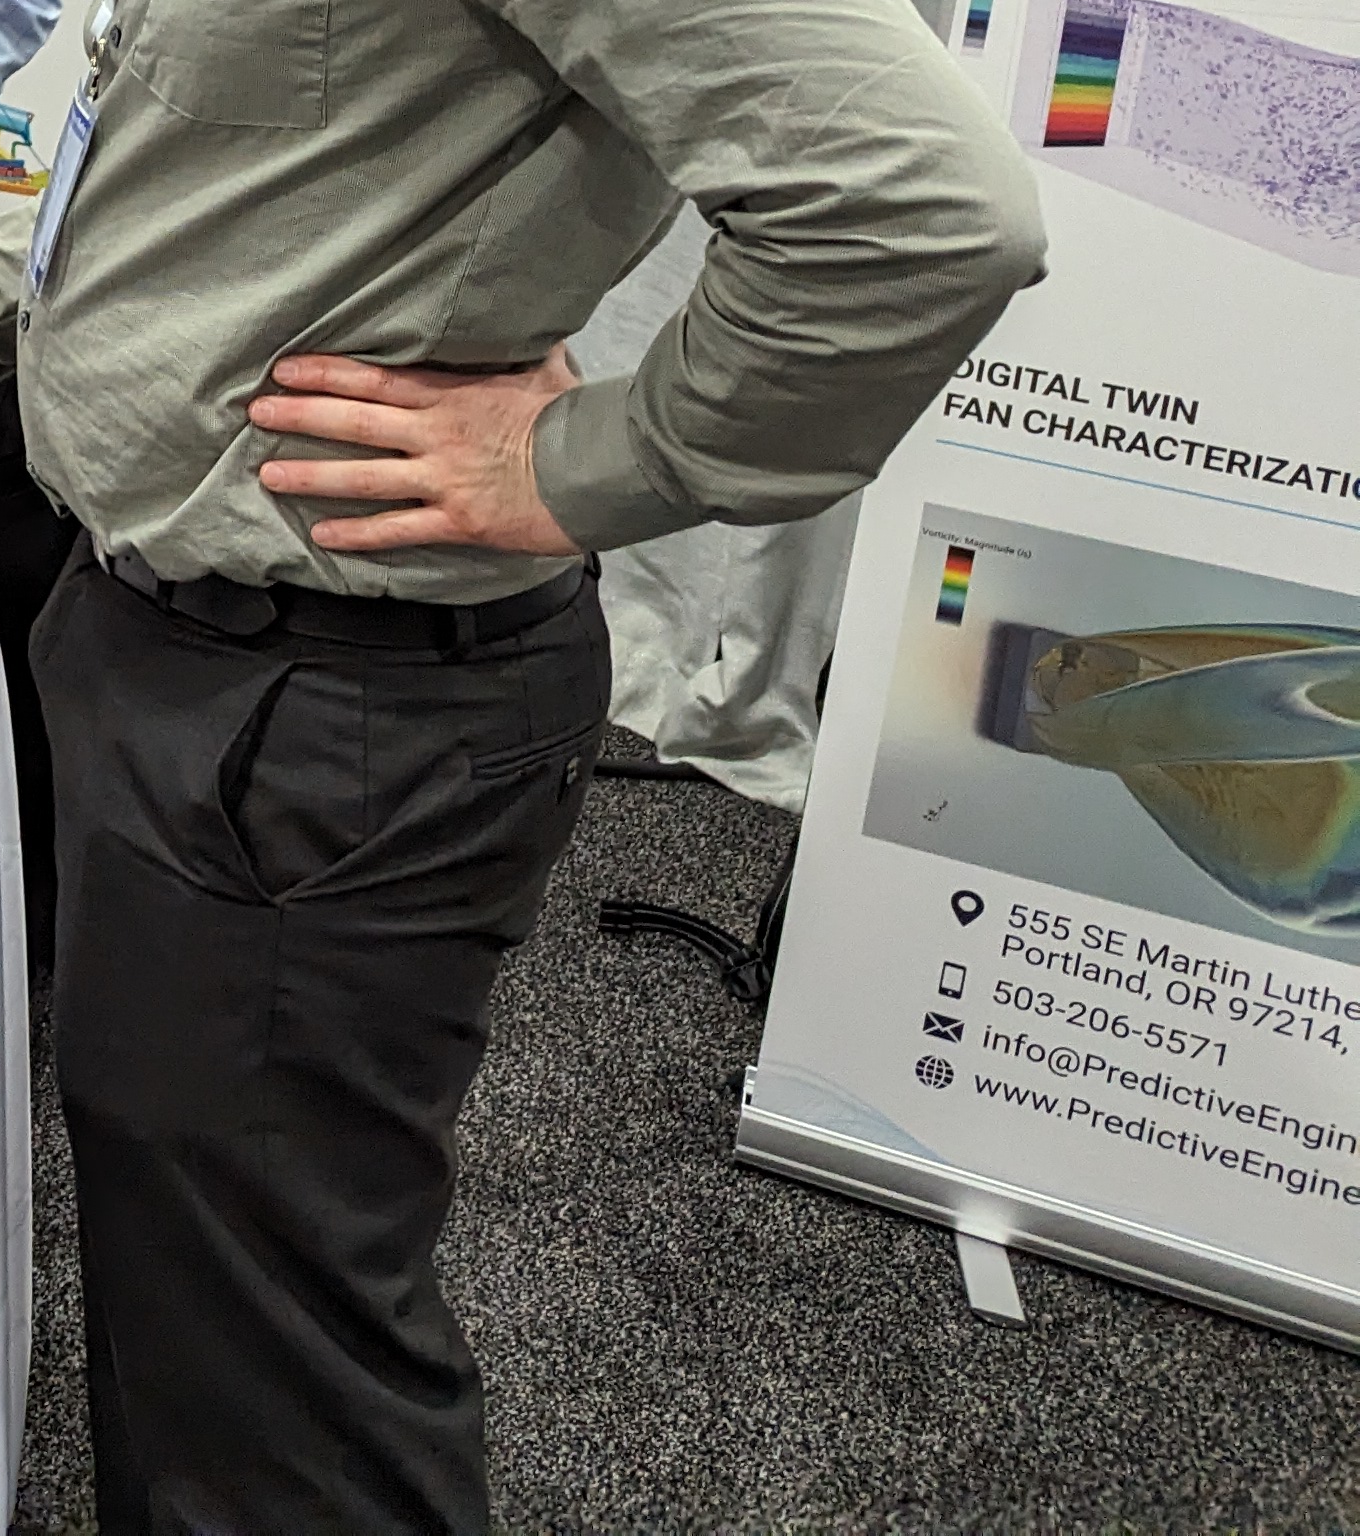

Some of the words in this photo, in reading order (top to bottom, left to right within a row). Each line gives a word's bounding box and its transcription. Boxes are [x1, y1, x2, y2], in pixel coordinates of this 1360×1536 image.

[942, 392, 1013, 429] FAN
[952, 357, 1091, 404] DIGITAL
[1102, 382, 1200, 425] TWIN
[1001, 933, 1152, 1002] Portland,
[1166, 980, 1218, 1015] OR
[1228, 996, 1349, 1056] 97214,
[1008, 903, 1072, 941] 555
[1081, 924, 1128, 957] SE
[1137, 937, 1251, 991] Martin
[1262, 971, 1360, 1021] Luthe
[992, 980, 1229, 1066] 503-206-5571
[974, 1073, 1360, 1206] www.PredictiveEngine
[982, 1025, 1359, 1155] info@PredictiveEngin
